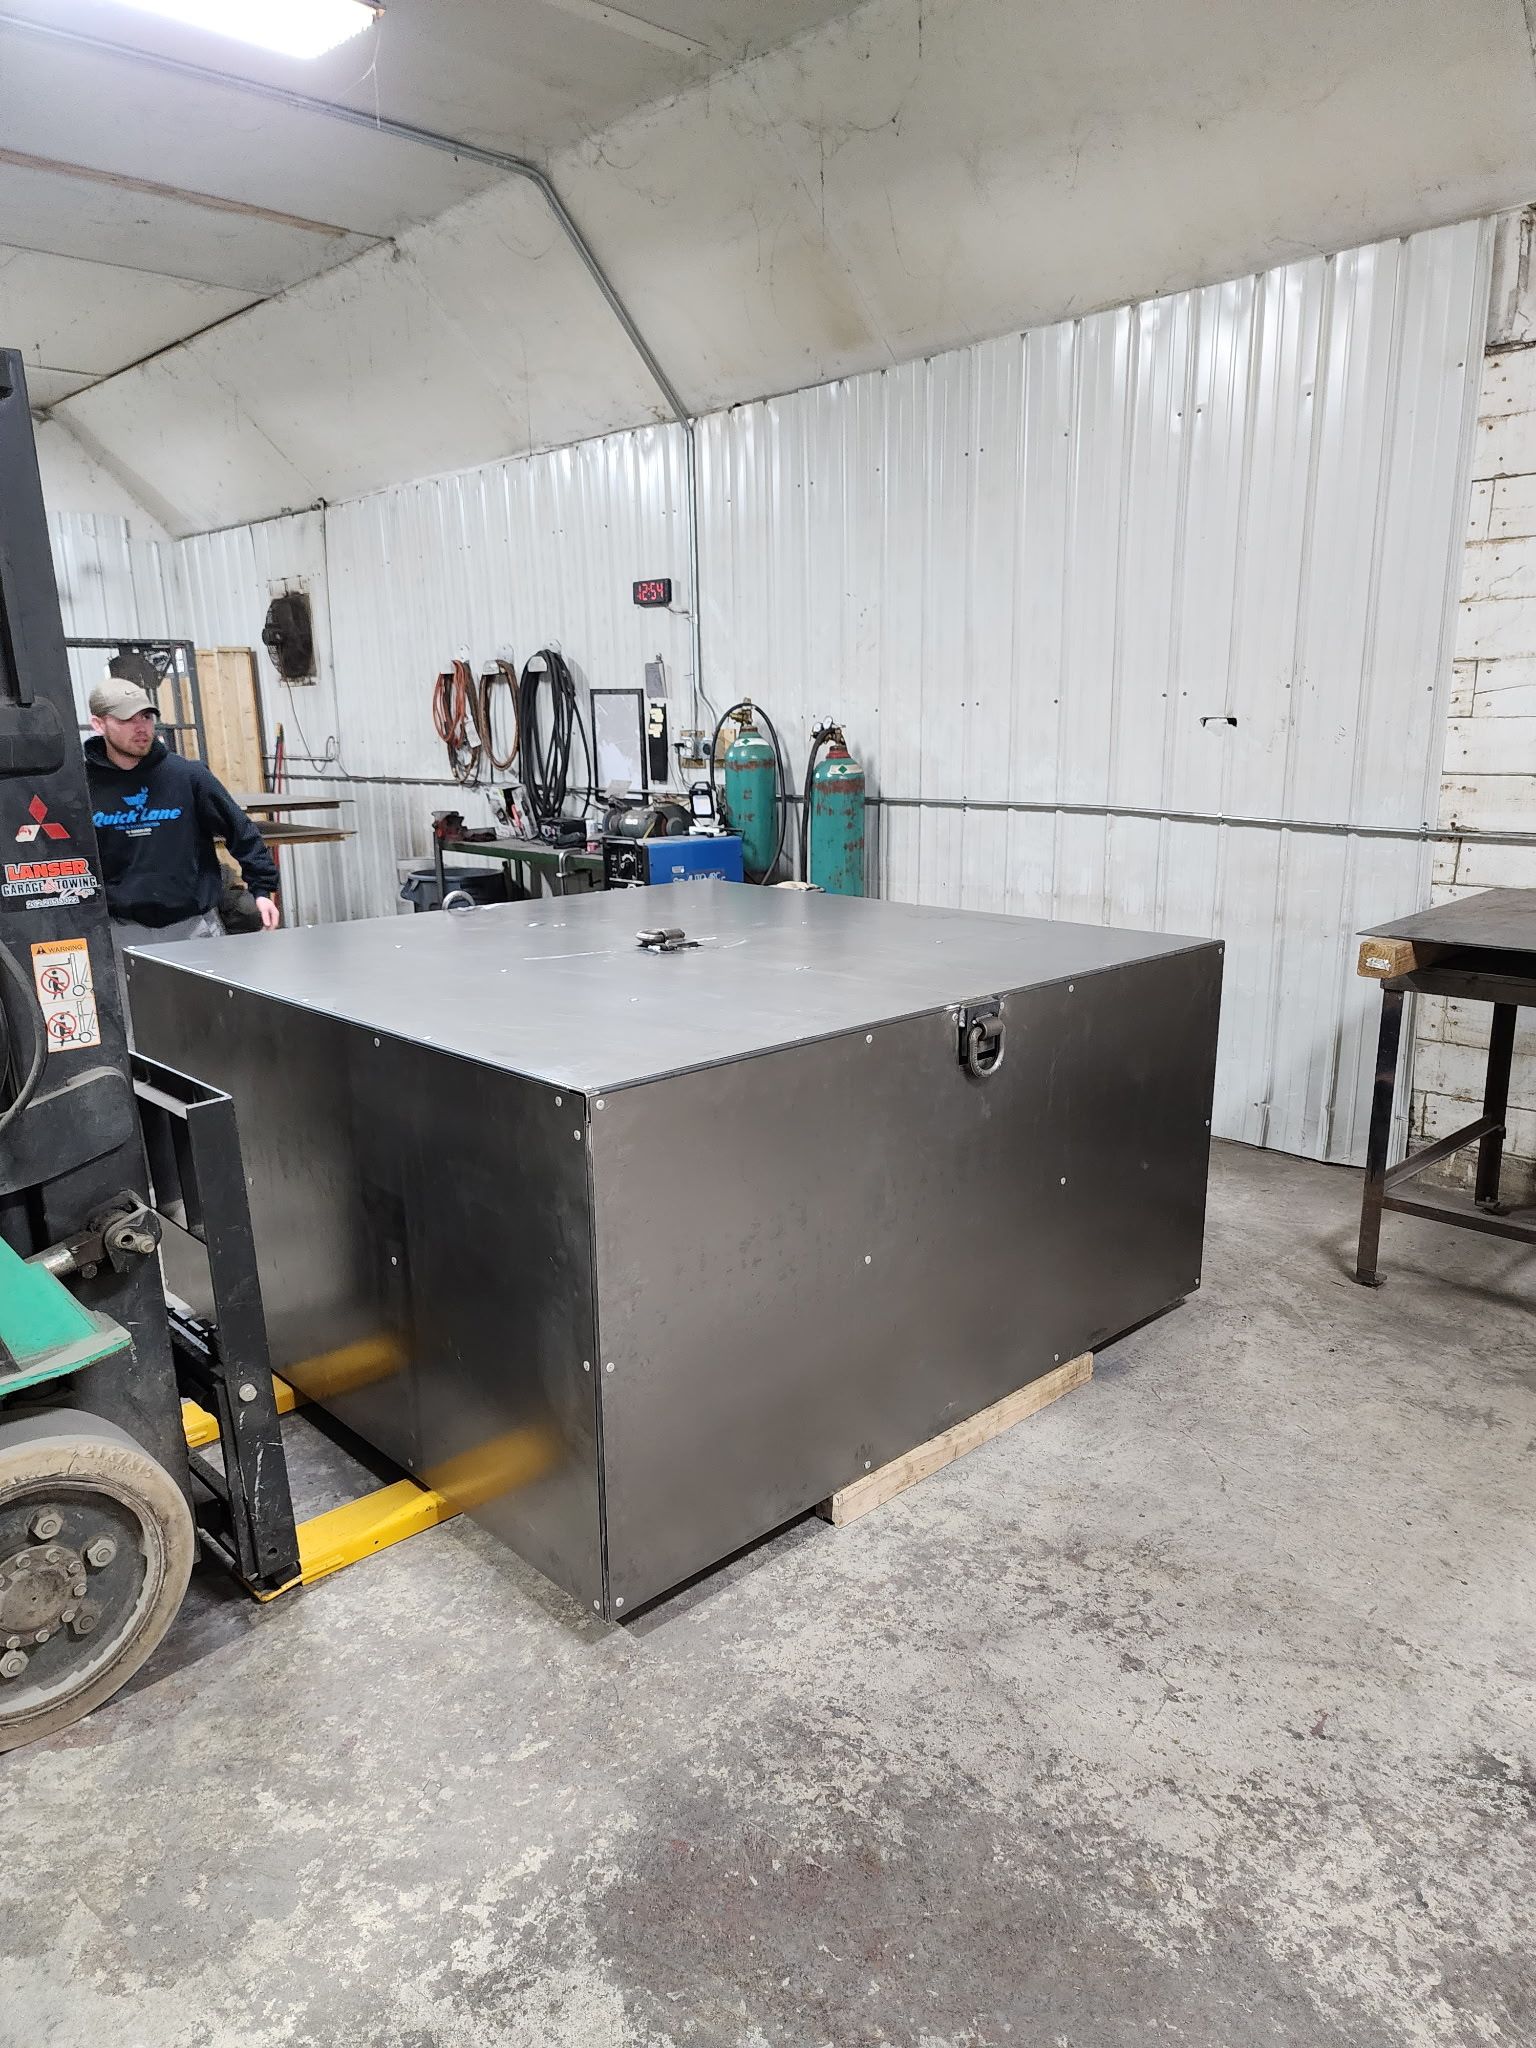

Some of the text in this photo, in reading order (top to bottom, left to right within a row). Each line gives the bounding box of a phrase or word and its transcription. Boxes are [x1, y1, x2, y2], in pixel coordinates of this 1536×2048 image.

[638, 582, 664, 601] 12:54
[92, 810, 138, 827] Quick
[140, 806, 182, 821] Lane
[7, 860, 87, 880] LANSER
[3, 881, 43, 896] GARAGE
[56, 877, 97, 890] TOWING
[47, 944, 83, 954] WARNING
